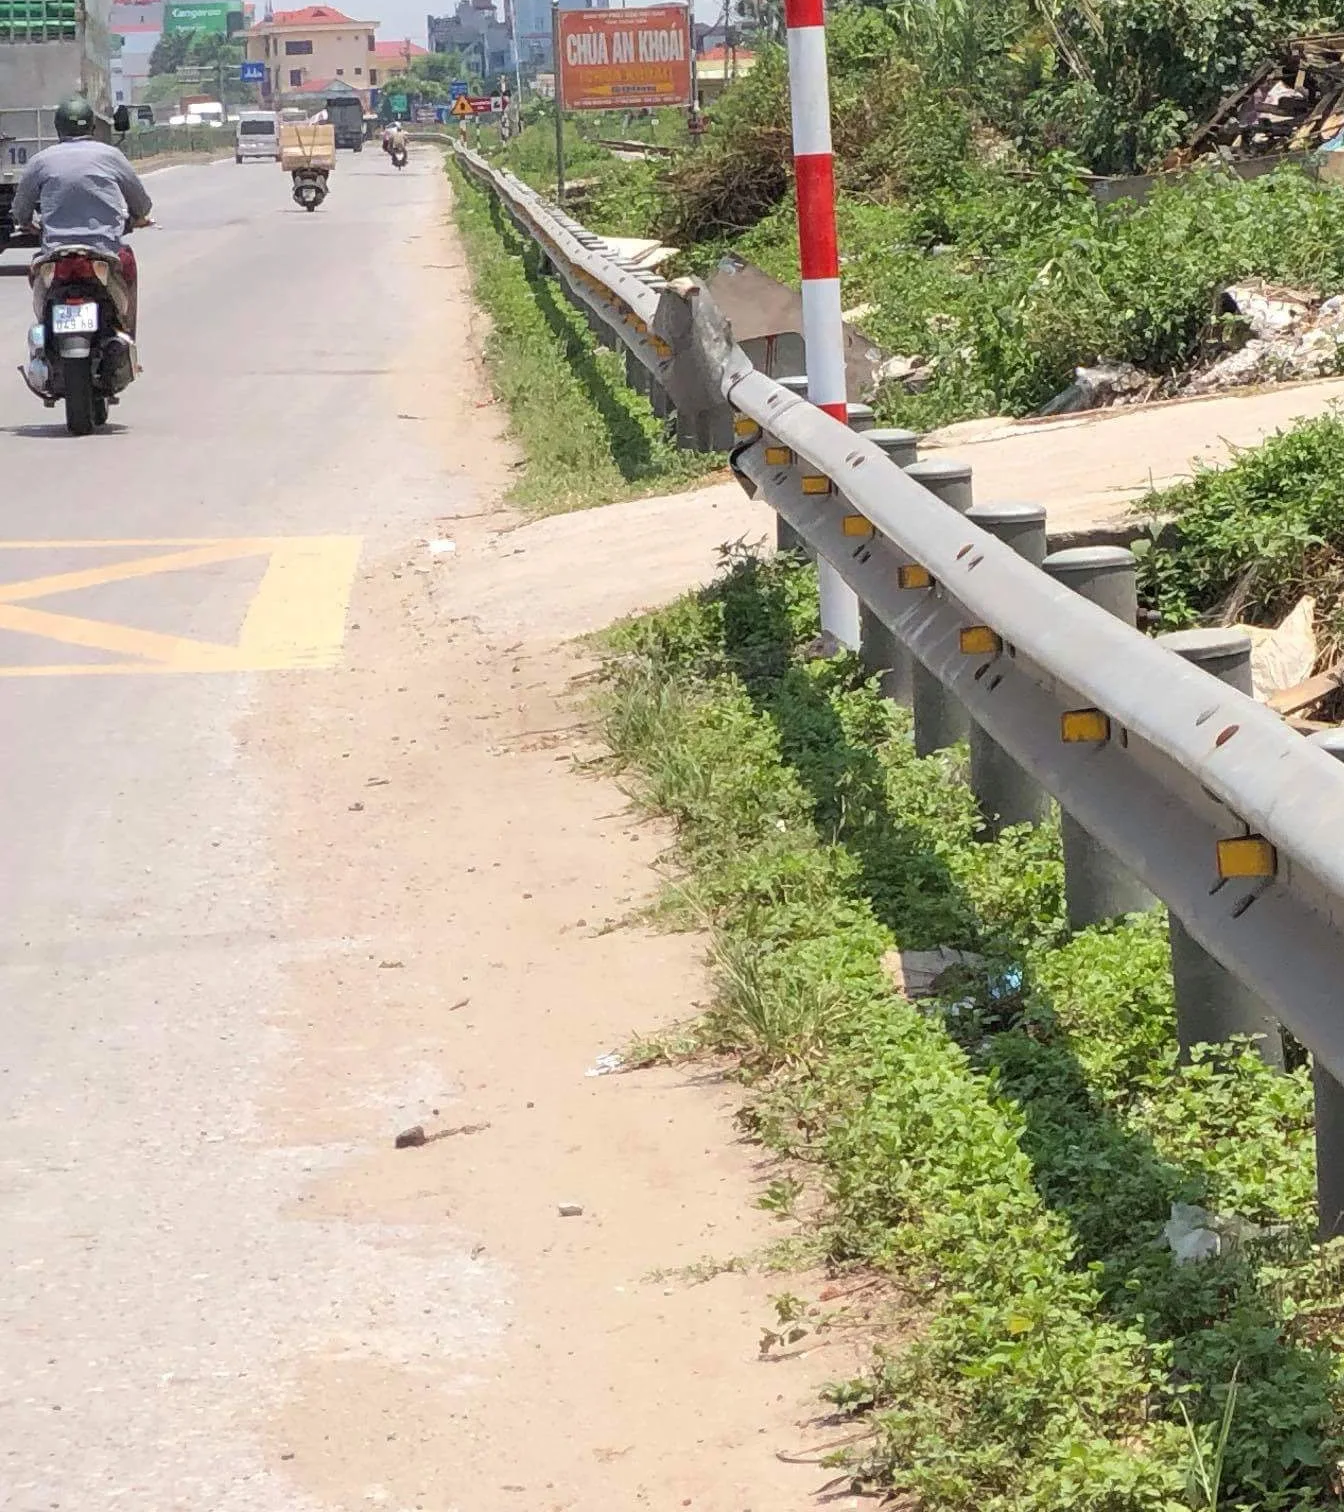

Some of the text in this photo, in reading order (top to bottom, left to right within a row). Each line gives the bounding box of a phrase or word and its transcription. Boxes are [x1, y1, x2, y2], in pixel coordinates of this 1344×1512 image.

[566, 22, 684, 66] CHÙA AN KHOÁI
